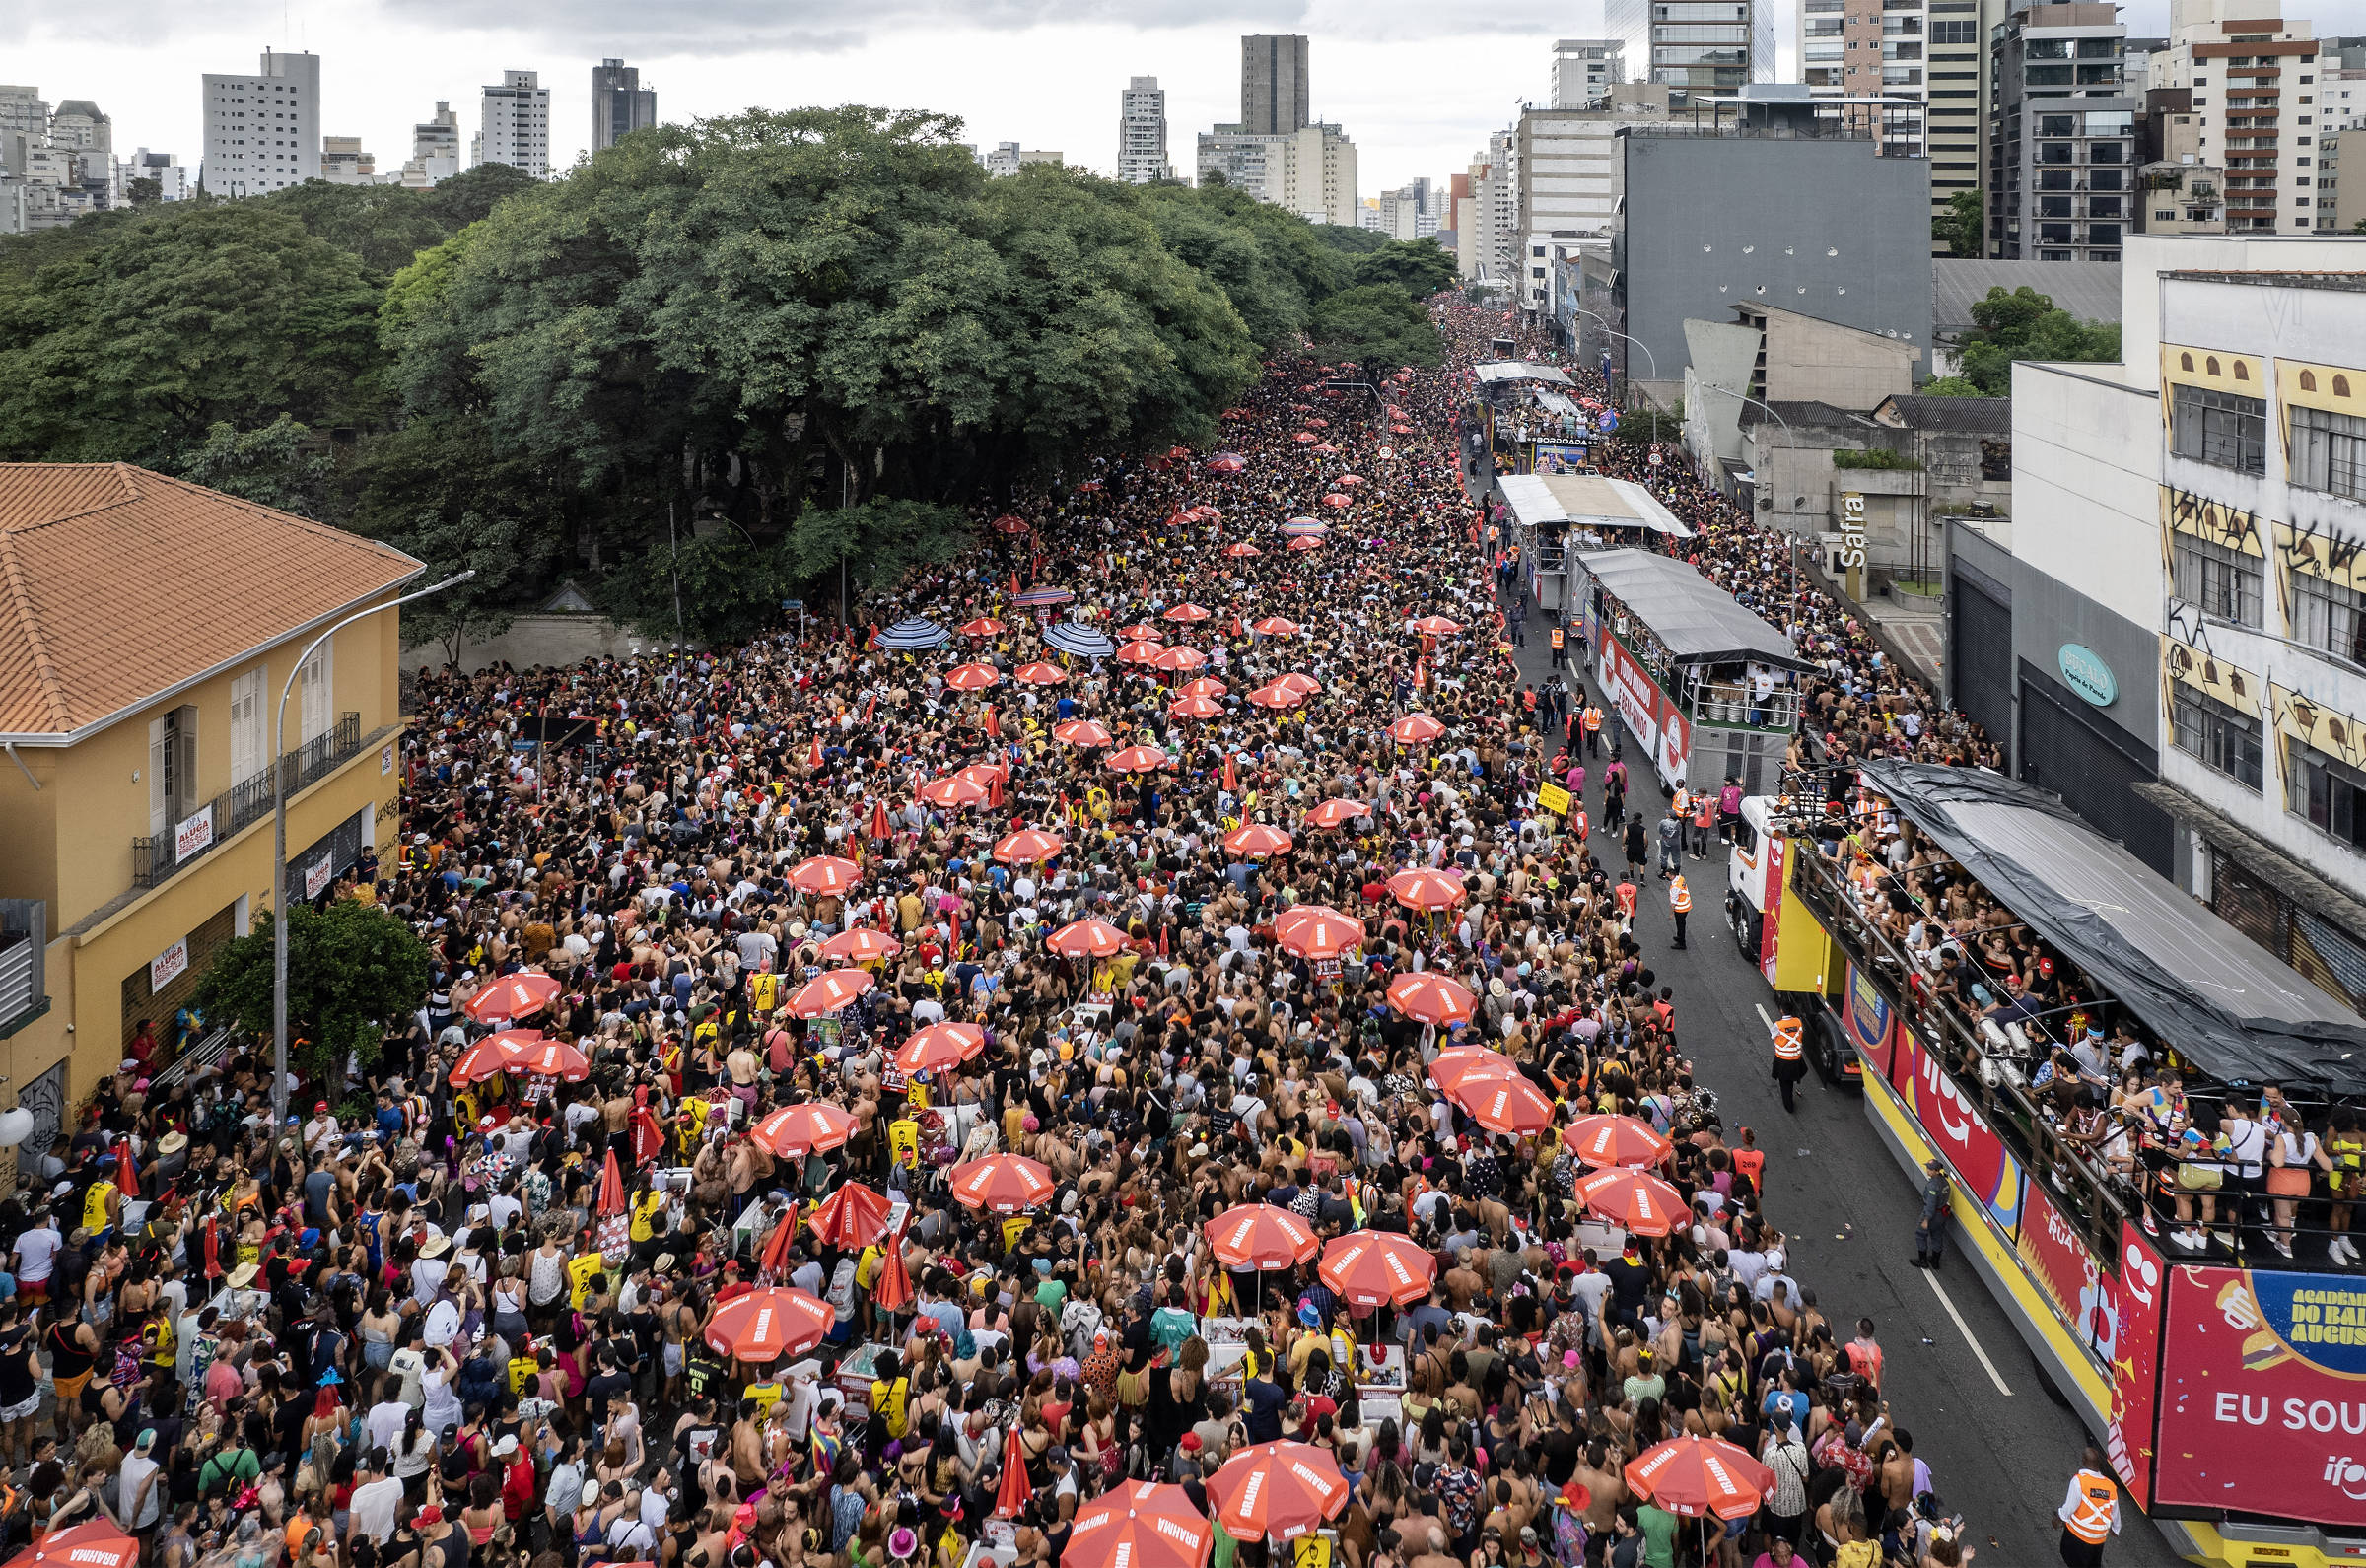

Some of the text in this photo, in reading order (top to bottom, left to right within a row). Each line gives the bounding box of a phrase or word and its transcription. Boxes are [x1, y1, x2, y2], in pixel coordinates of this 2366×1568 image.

[1840, 496, 1865, 568] Safra
[1620, 656, 1651, 710] TODO MUNDO
[2065, 650, 2108, 689] BUCALO
[178, 820, 209, 845] ALUGA
[308, 862, 330, 885] ALUGA
[155, 946, 183, 973] ALUGA
[1491, 1091, 1508, 1118] BRAHMA
[1595, 1127, 1613, 1153] BRAHMA
[969, 1165, 996, 1191] BRAHMA
[1585, 1174, 1617, 1192] BRAHMA
[1635, 1189, 1652, 1218] BRAHMA
[1229, 1218, 1255, 1249] BRAHMA
[1276, 1216, 1307, 1245] BRAHMA
[2048, 1215, 2073, 1255] RUA
[1333, 1246, 1363, 1274] BRAHMA
[1385, 1251, 1412, 1284] BRAHMA
[792, 1295, 825, 1318] BRAHMA
[2291, 1303, 2321, 1323] DO
[2215, 1392, 2366, 1435] EU SOU
[1640, 1447, 1677, 1477] BRAHMA
[1705, 1457, 1737, 1494] BRAHMA
[1291, 1462, 1332, 1496] BRAHMA
[1240, 1471, 1265, 1518] BRAHMA
[1073, 1512, 1109, 1535] BRAHMA
[1157, 1517, 1199, 1549] BRAHMA
[70, 1549, 120, 1566] BRAHMA
